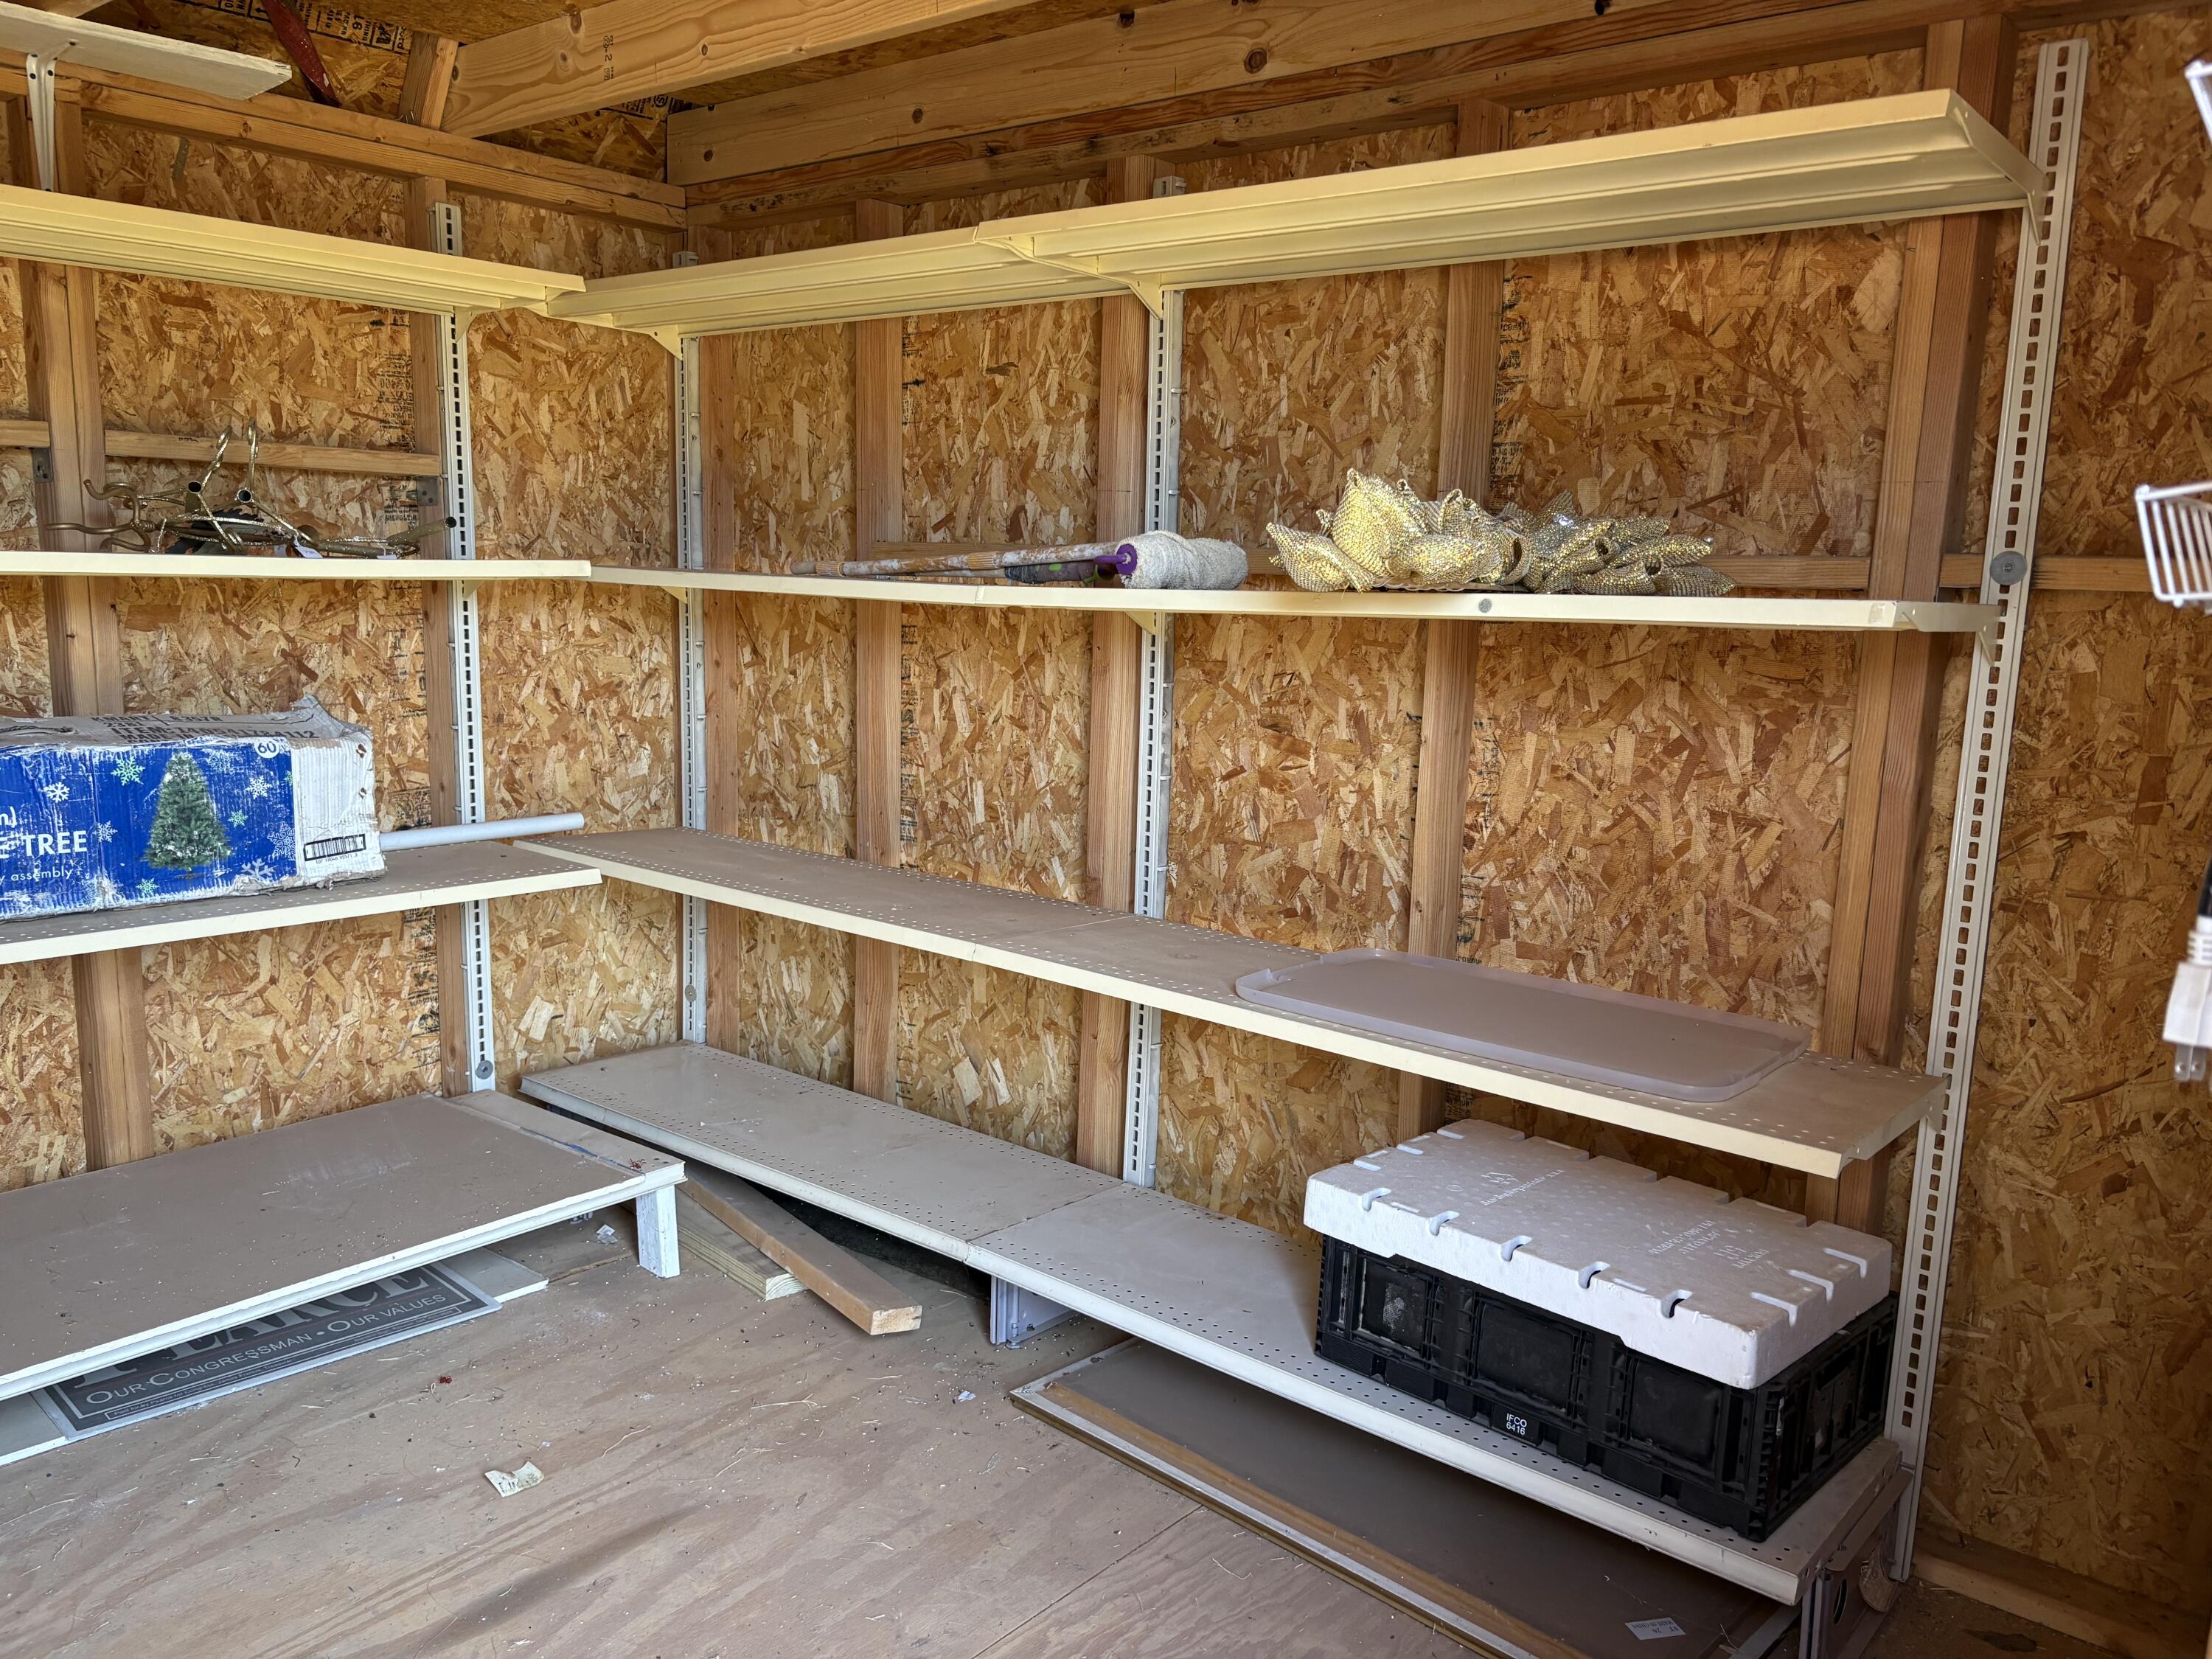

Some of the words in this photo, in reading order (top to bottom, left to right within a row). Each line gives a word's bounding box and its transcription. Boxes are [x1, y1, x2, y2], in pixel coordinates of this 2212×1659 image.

[258, 740, 276, 754] 60
[20, 831, 88, 857] TREE
[10, 866, 73, 881] assembly
[86, 1383, 146, 1405] OUR
[150, 1333, 313, 1385] CONGRESSMAN
[327, 1313, 380, 1332] OUR
[379, 1295, 445, 1317] VALUES
[1506, 1413, 1527, 1427] IFCO
[1506, 1422, 1526, 1436] 6416
